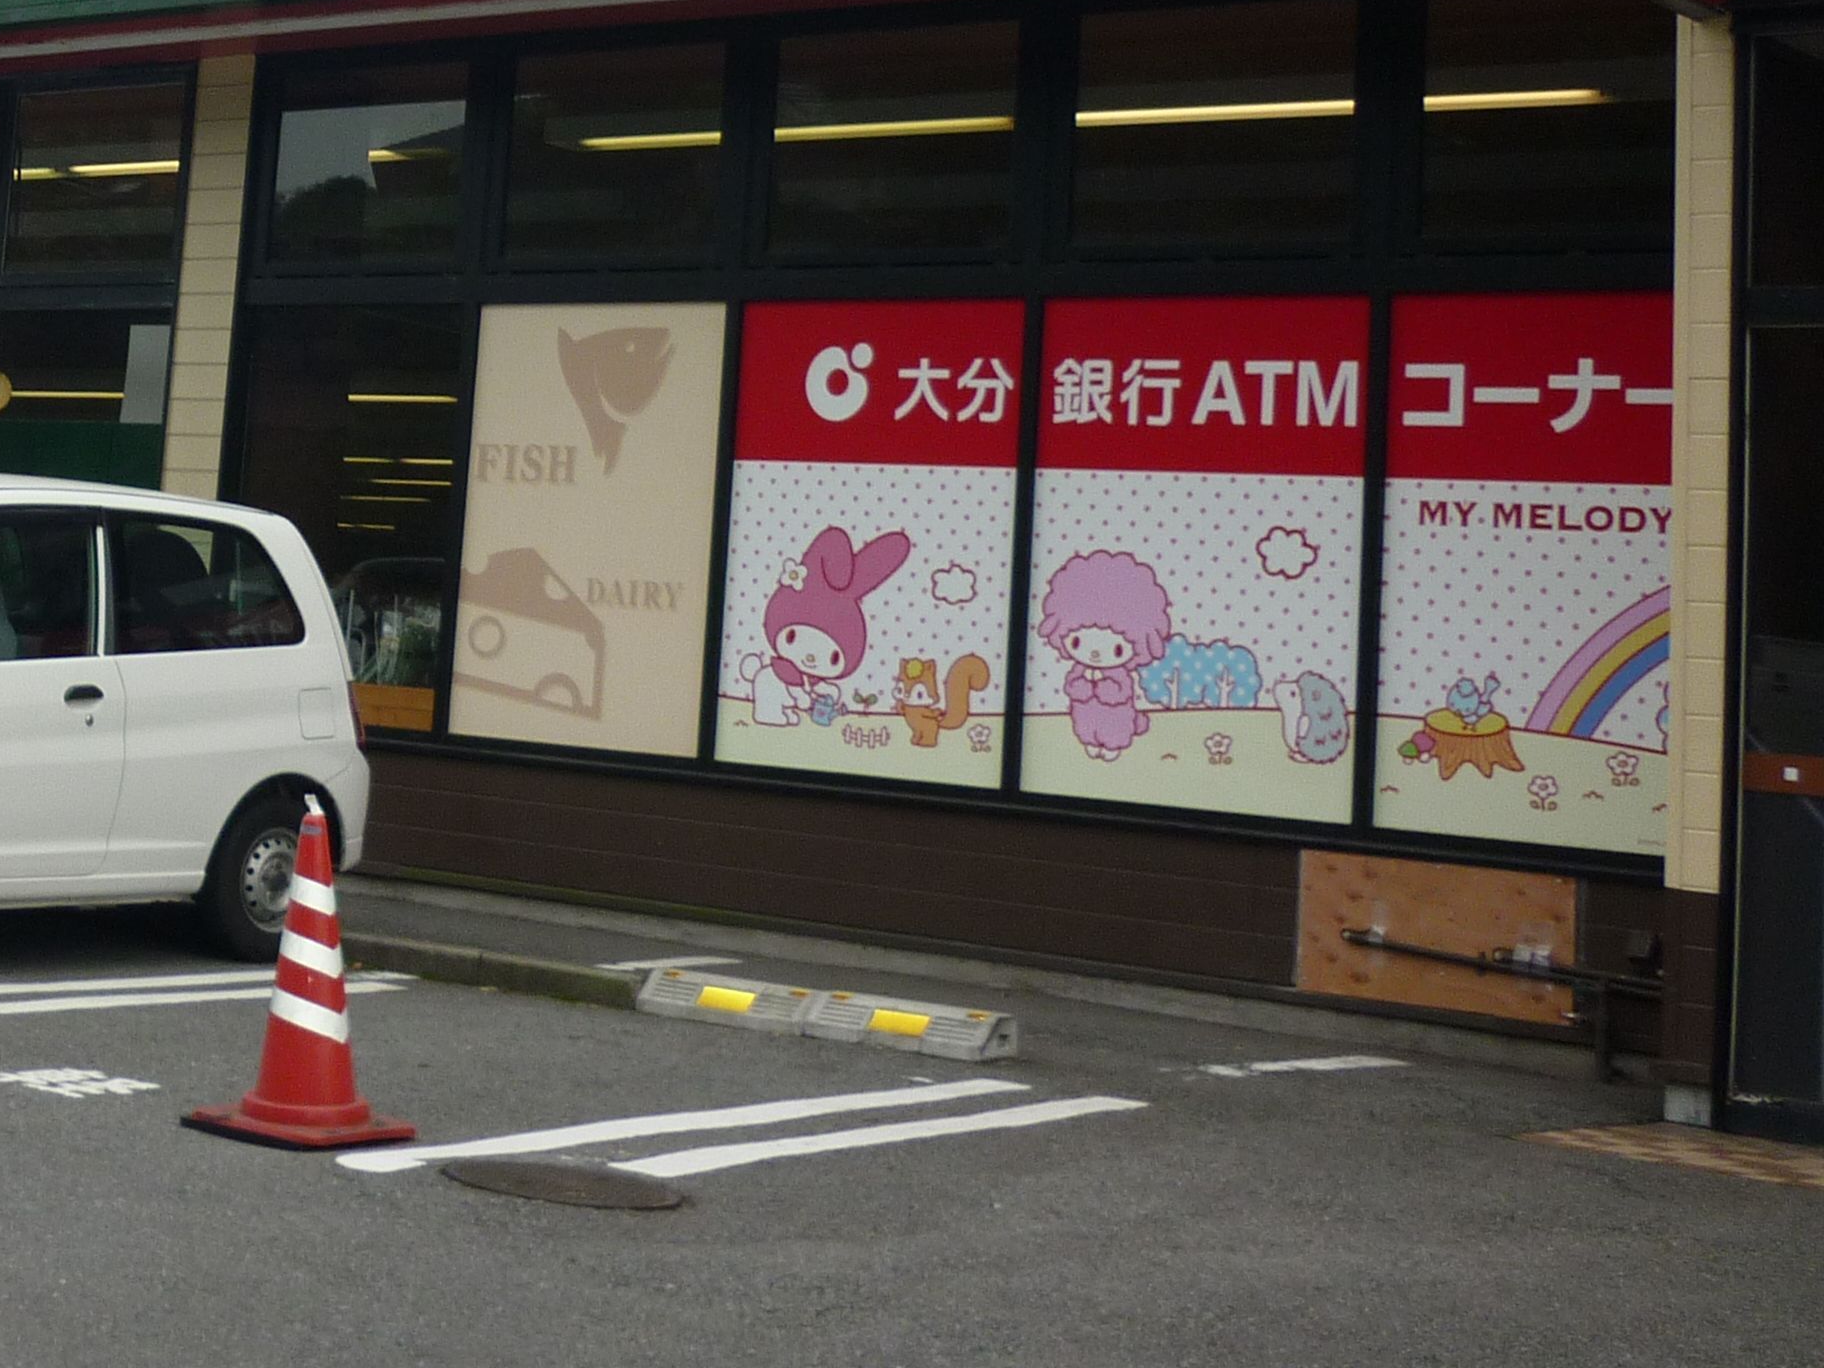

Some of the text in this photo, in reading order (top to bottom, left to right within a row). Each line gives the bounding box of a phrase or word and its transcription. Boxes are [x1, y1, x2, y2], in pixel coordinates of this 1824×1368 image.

[893, 356, 1015, 424] 大分
[475, 442, 578, 484] FISH
[1417, 500, 1672, 534] MY MELODY
[586, 577, 684, 612] DAIRY
